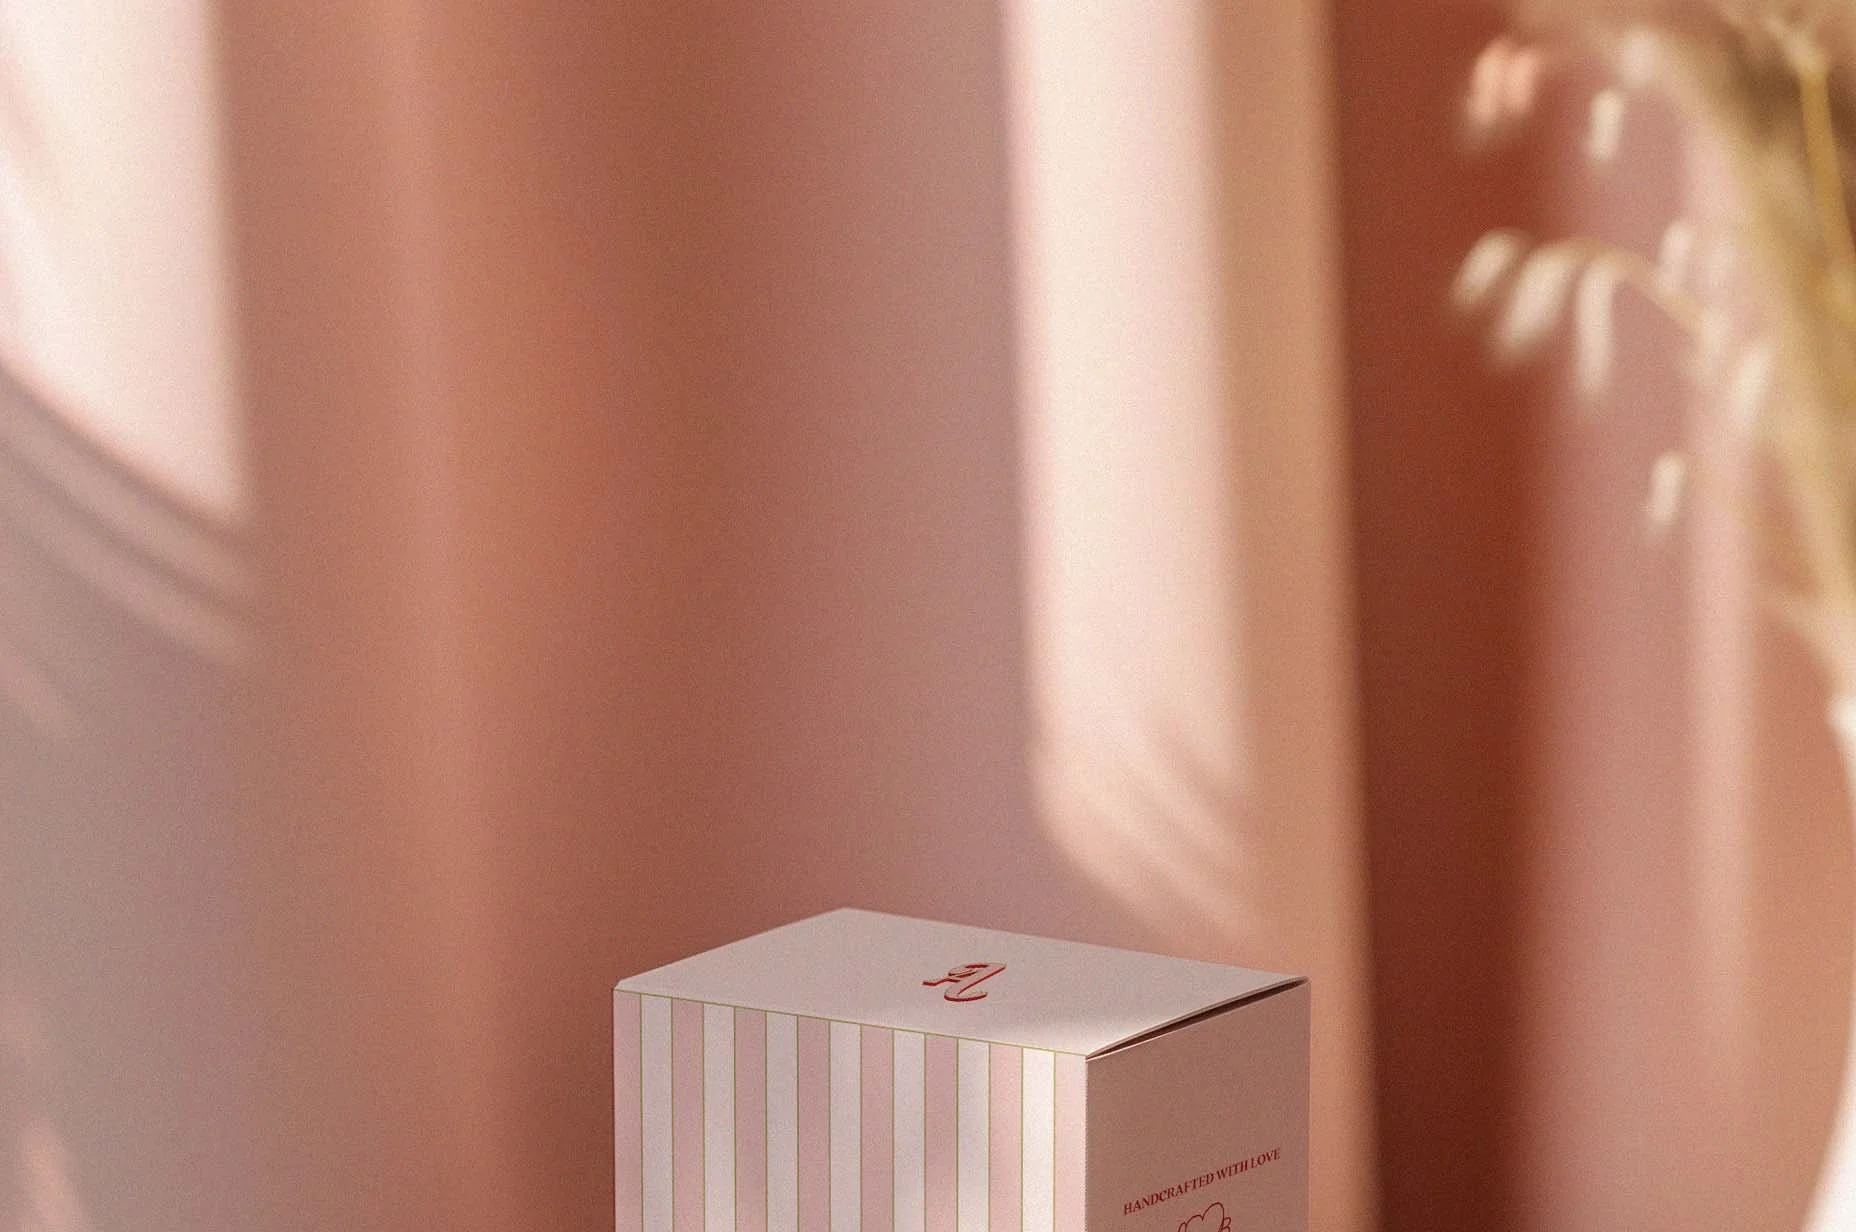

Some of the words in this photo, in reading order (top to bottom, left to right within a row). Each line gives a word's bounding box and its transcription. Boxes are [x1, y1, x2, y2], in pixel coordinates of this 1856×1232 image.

[1123, 1172, 1215, 1216] HANDCRAFTED
[1215, 1160, 1248, 1181] WITH
[1250, 1148, 1281, 1169] LOVE
